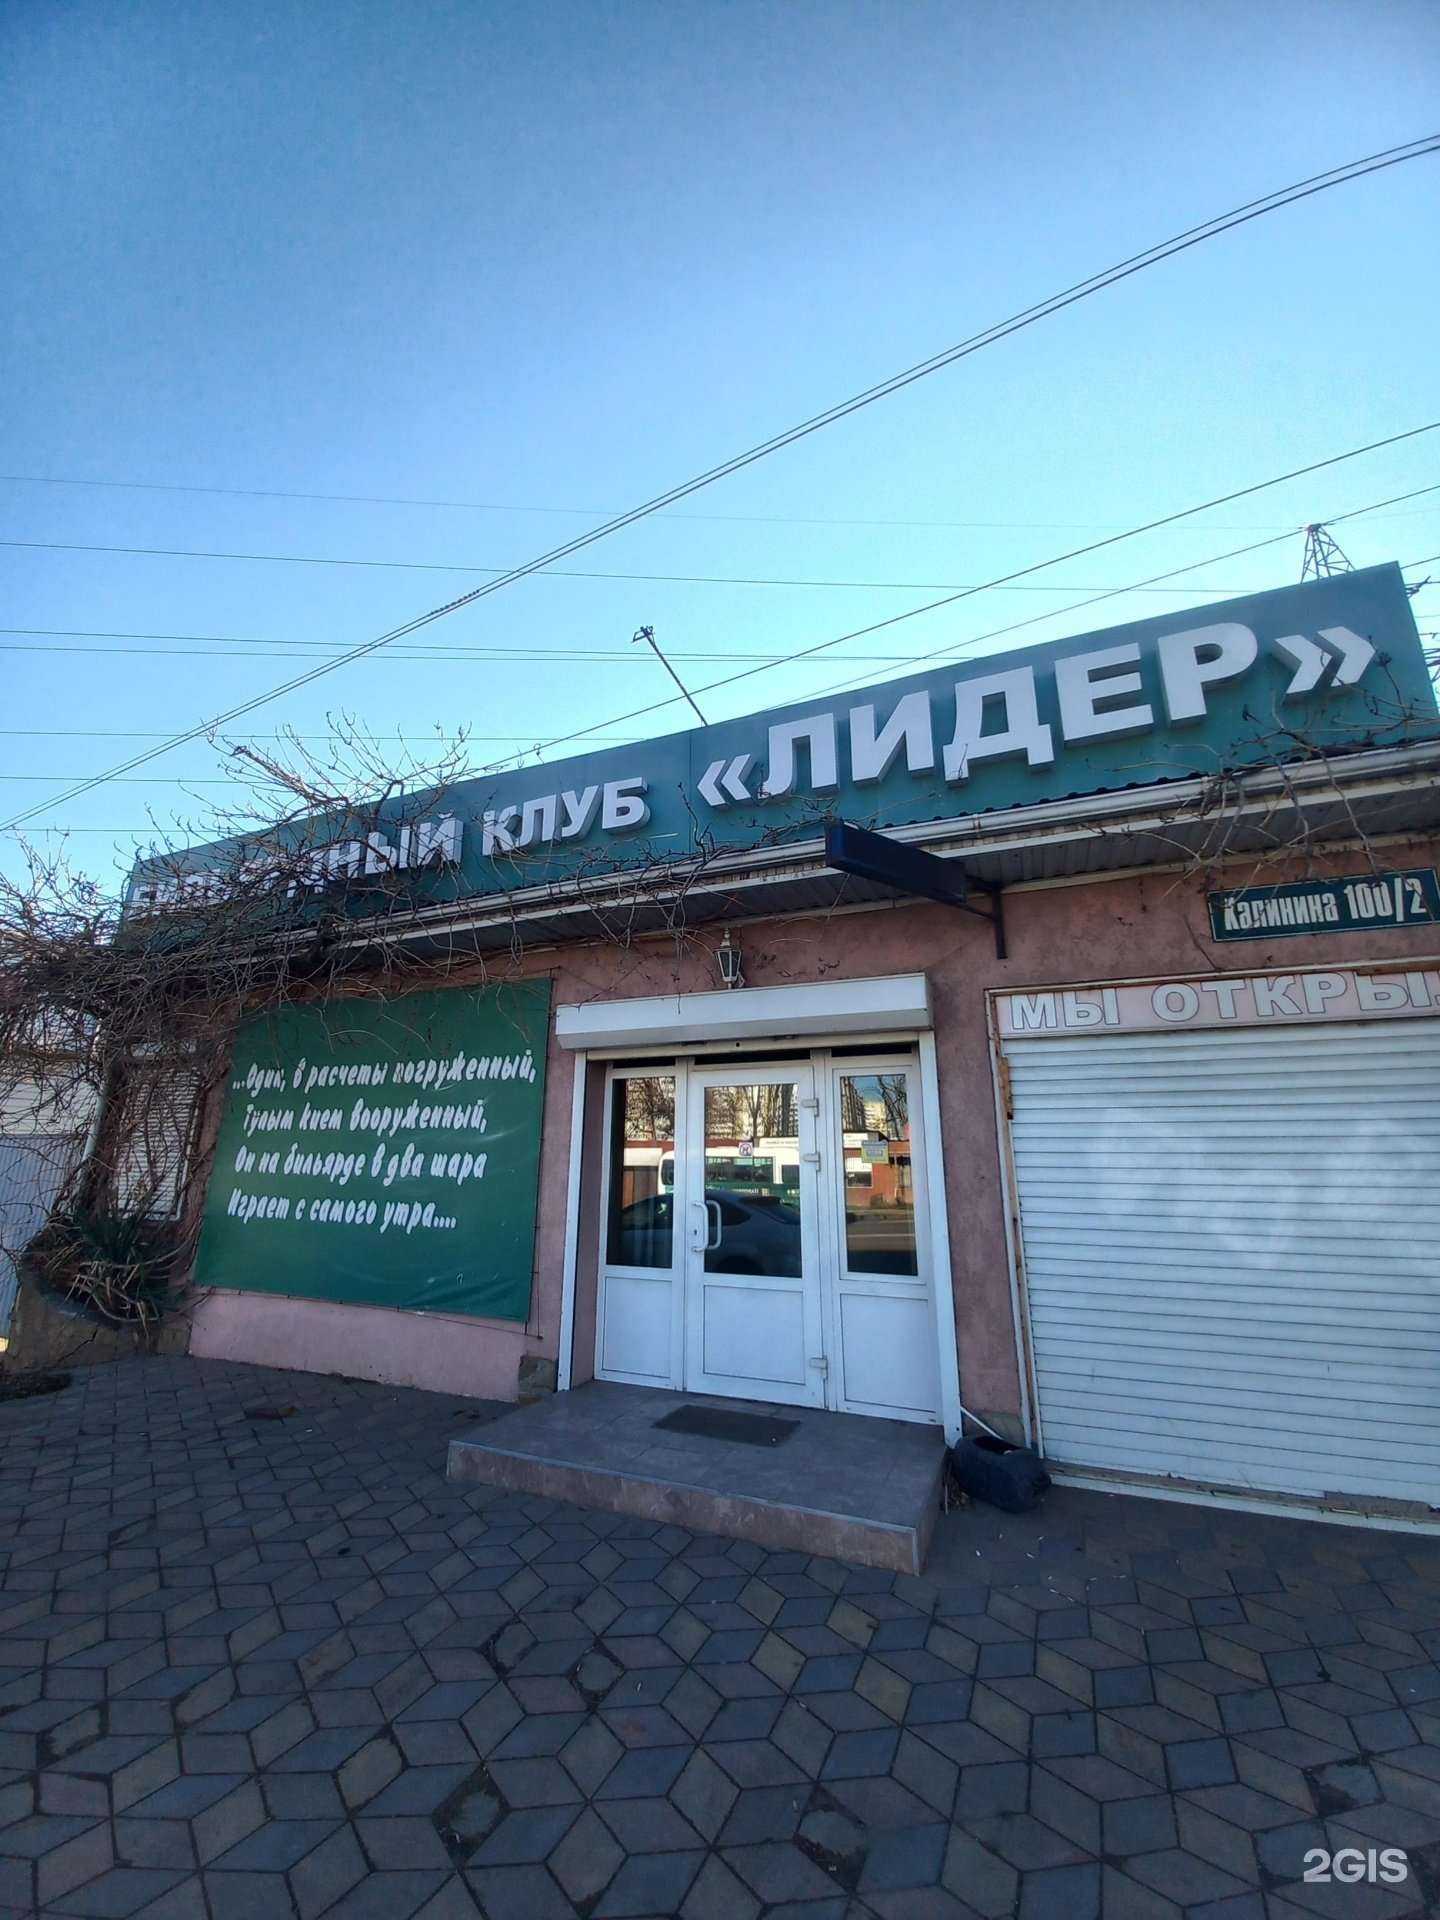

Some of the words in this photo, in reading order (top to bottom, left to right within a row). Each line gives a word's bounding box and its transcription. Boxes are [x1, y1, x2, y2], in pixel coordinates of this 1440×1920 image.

[481, 777, 650, 858] КЛУБ
[696, 622, 1376, 807] «ЛИДЕР»
[1224, 893, 1339, 931] Калинина
[1344, 878, 1428, 922] 100/2
[1010, 987, 1121, 1031] МЫ
[1151, 970, 1440, 1023] ОТКРЫ
[304, 1062, 388, 1094] расчеты
[393, 1049, 536, 1090] погруженный,
[243, 1103, 294, 1137] Тупым
[350, 1098, 488, 1137] вооруженный,
[235, 1145, 256, 1173] Он
[258, 1150, 280, 1174] на
[284, 1142, 366, 1186] бильярде
[371, 1142, 386, 1178] в
[383, 1143, 425, 1187] два
[430, 1151, 488, 1185] шара
[228, 1187, 290, 1224] Играет
[295, 1198, 306, 1220] с
[310, 1198, 377, 1225] самого
